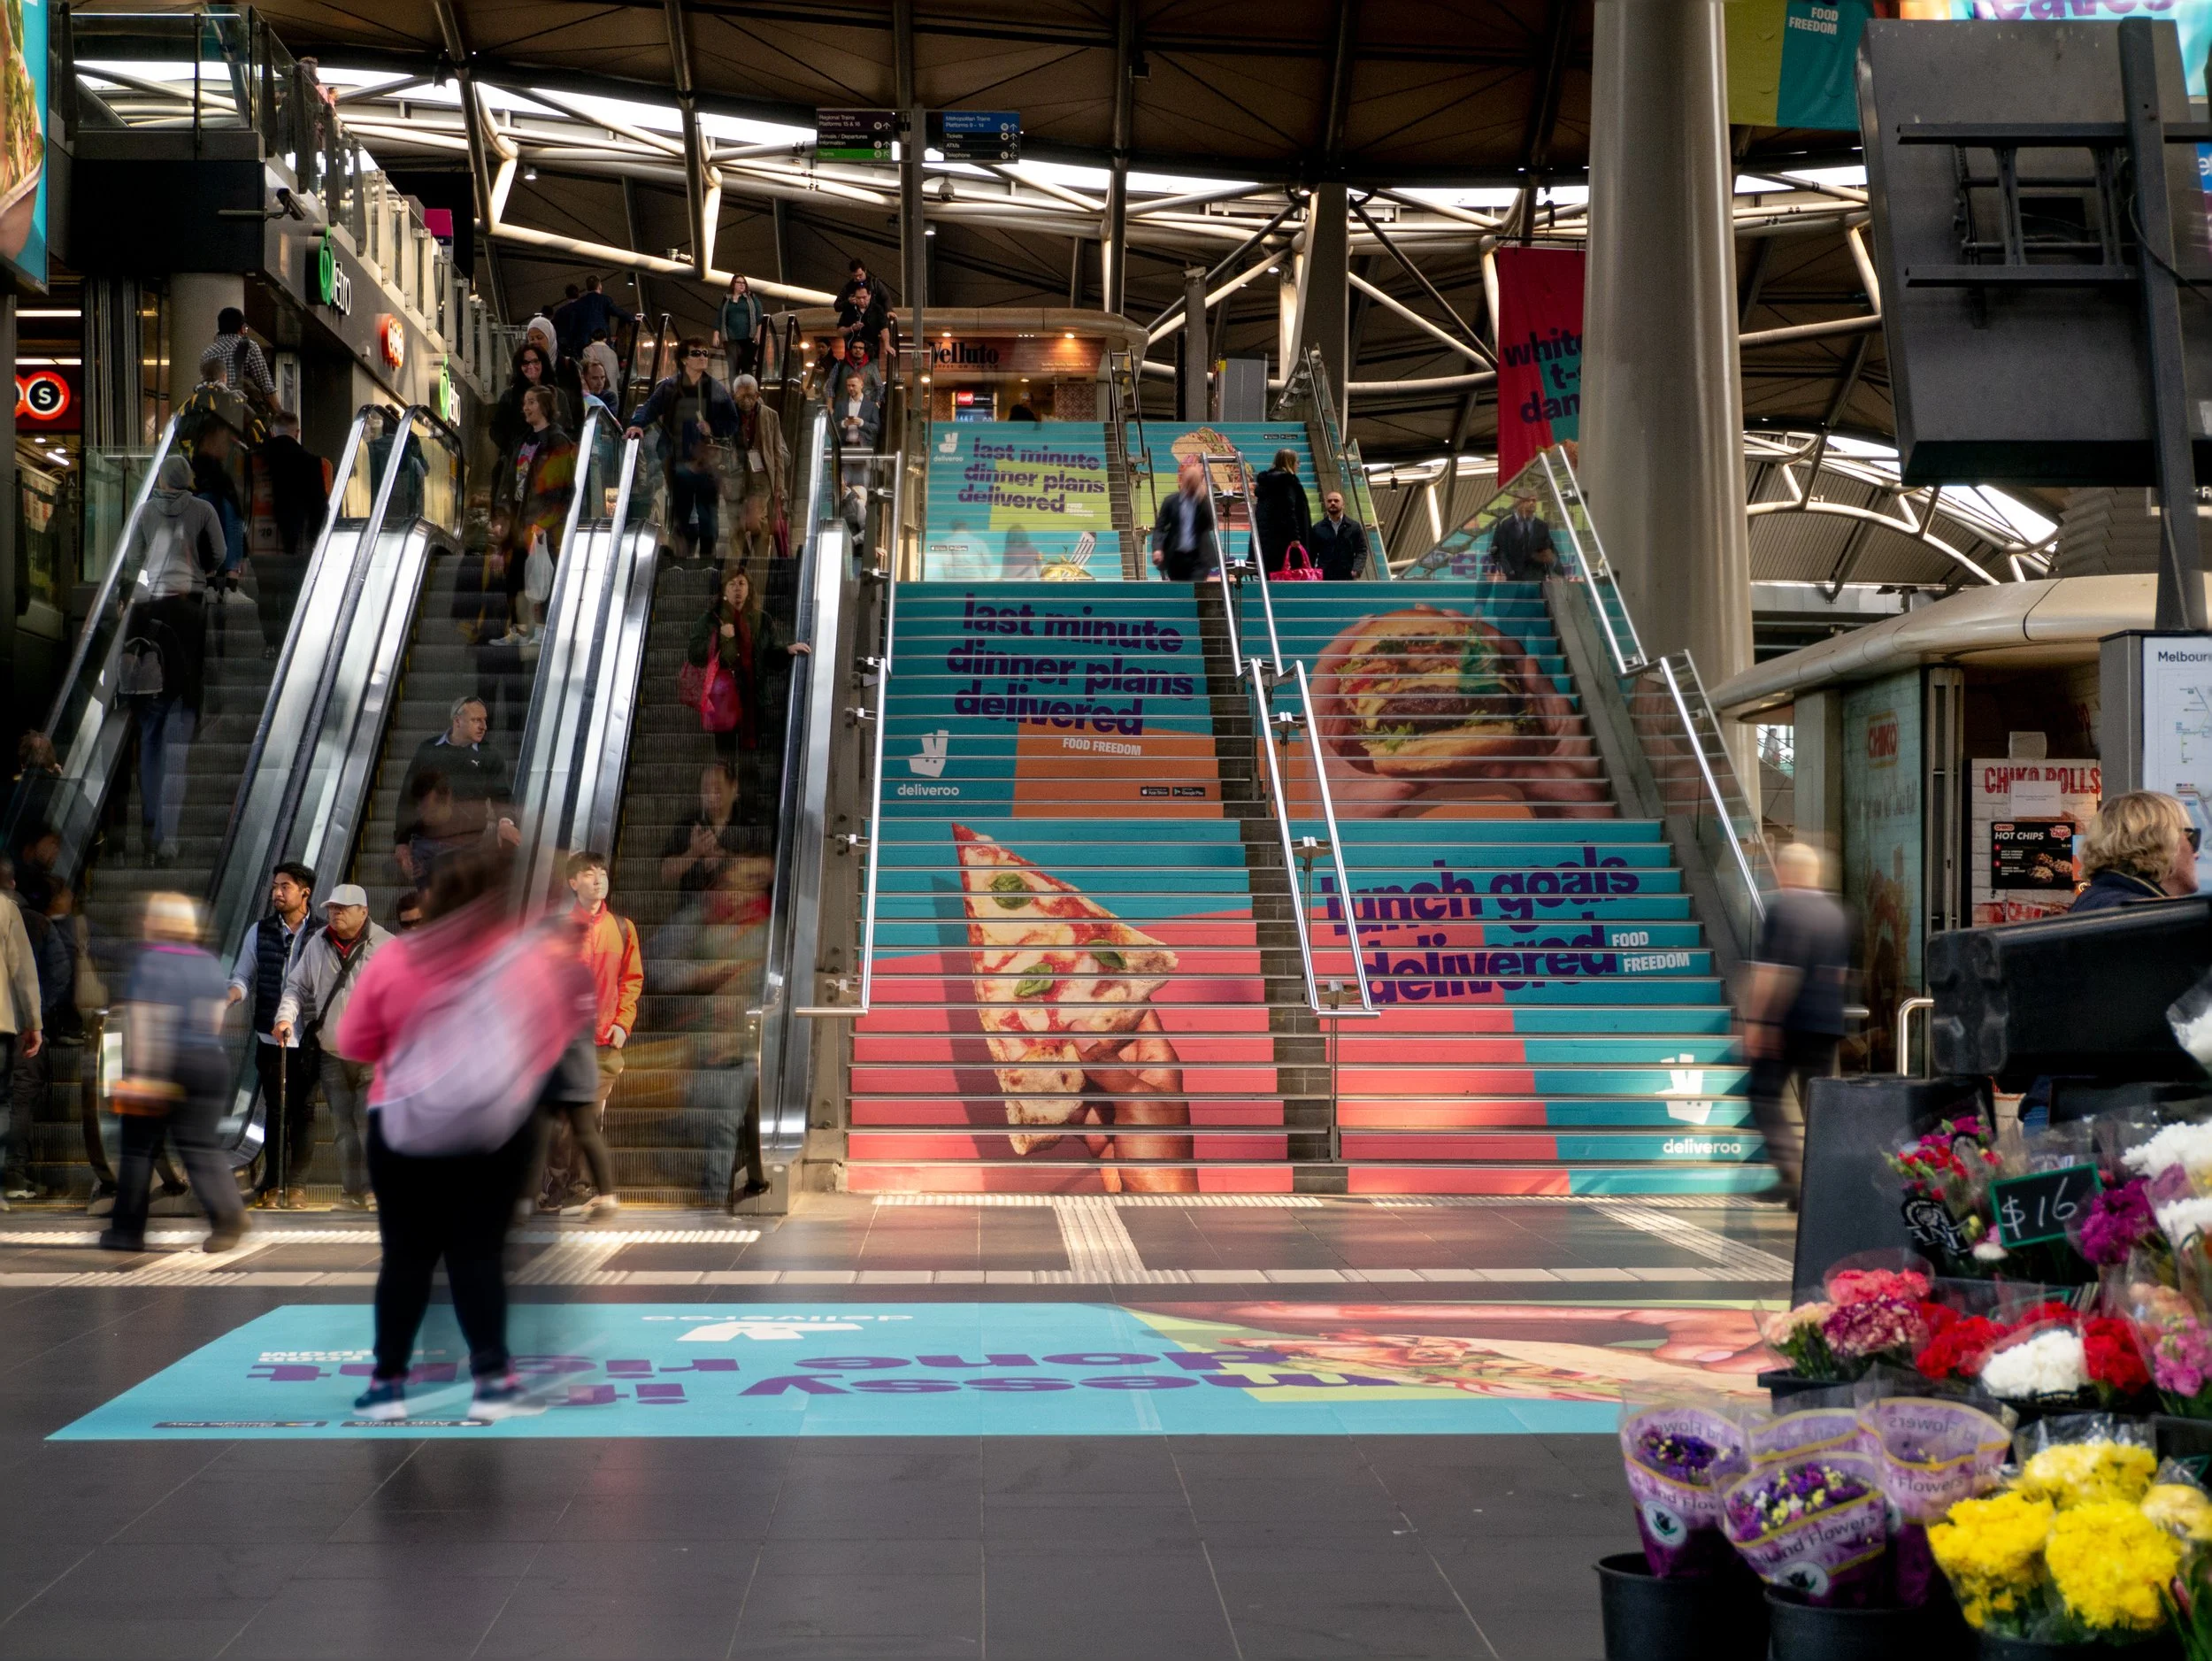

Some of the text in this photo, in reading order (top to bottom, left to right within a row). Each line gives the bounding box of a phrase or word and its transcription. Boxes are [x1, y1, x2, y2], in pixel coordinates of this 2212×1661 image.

[1811, 7, 1839, 21] FOOD
[1789, 17, 1838, 35] FREEDOM
[332, 259, 351, 316] etro
[928, 342, 1000, 364] Velluto
[1550, 363, 1581, 389] t-
[38, 388, 52, 404] S
[933, 454, 964, 463] deliveroo
[973, 437, 1101, 471] last minute
[964, 463, 1105, 494] dinner plans
[957, 484, 1065, 514] delivered
[963, 593, 1184, 653] last minute
[947, 639, 1194, 701] dinner plans
[954, 680, 1143, 736] delivered
[1063, 737, 1141, 756] FOOD FREEDOM
[1868, 723, 1898, 759] CHIKO
[896, 784, 960, 797] deliveroo
[2016, 832, 2045, 841] CHIPS
[1320, 842, 1640, 936] lunch goals
[1611, 931, 1649, 947] FOOD
[1356, 911, 1619, 1004] delivered
[1623, 952, 1691, 973] FREEDOM
[1663, 1138, 1741, 1154] deliveroo
[794, 1350, 1290, 1371] done
[737, 1373, 1402, 1396] messy
[1898, 1473, 1964, 1493] Flowers
[1808, 1514, 1876, 1547] Flowers
